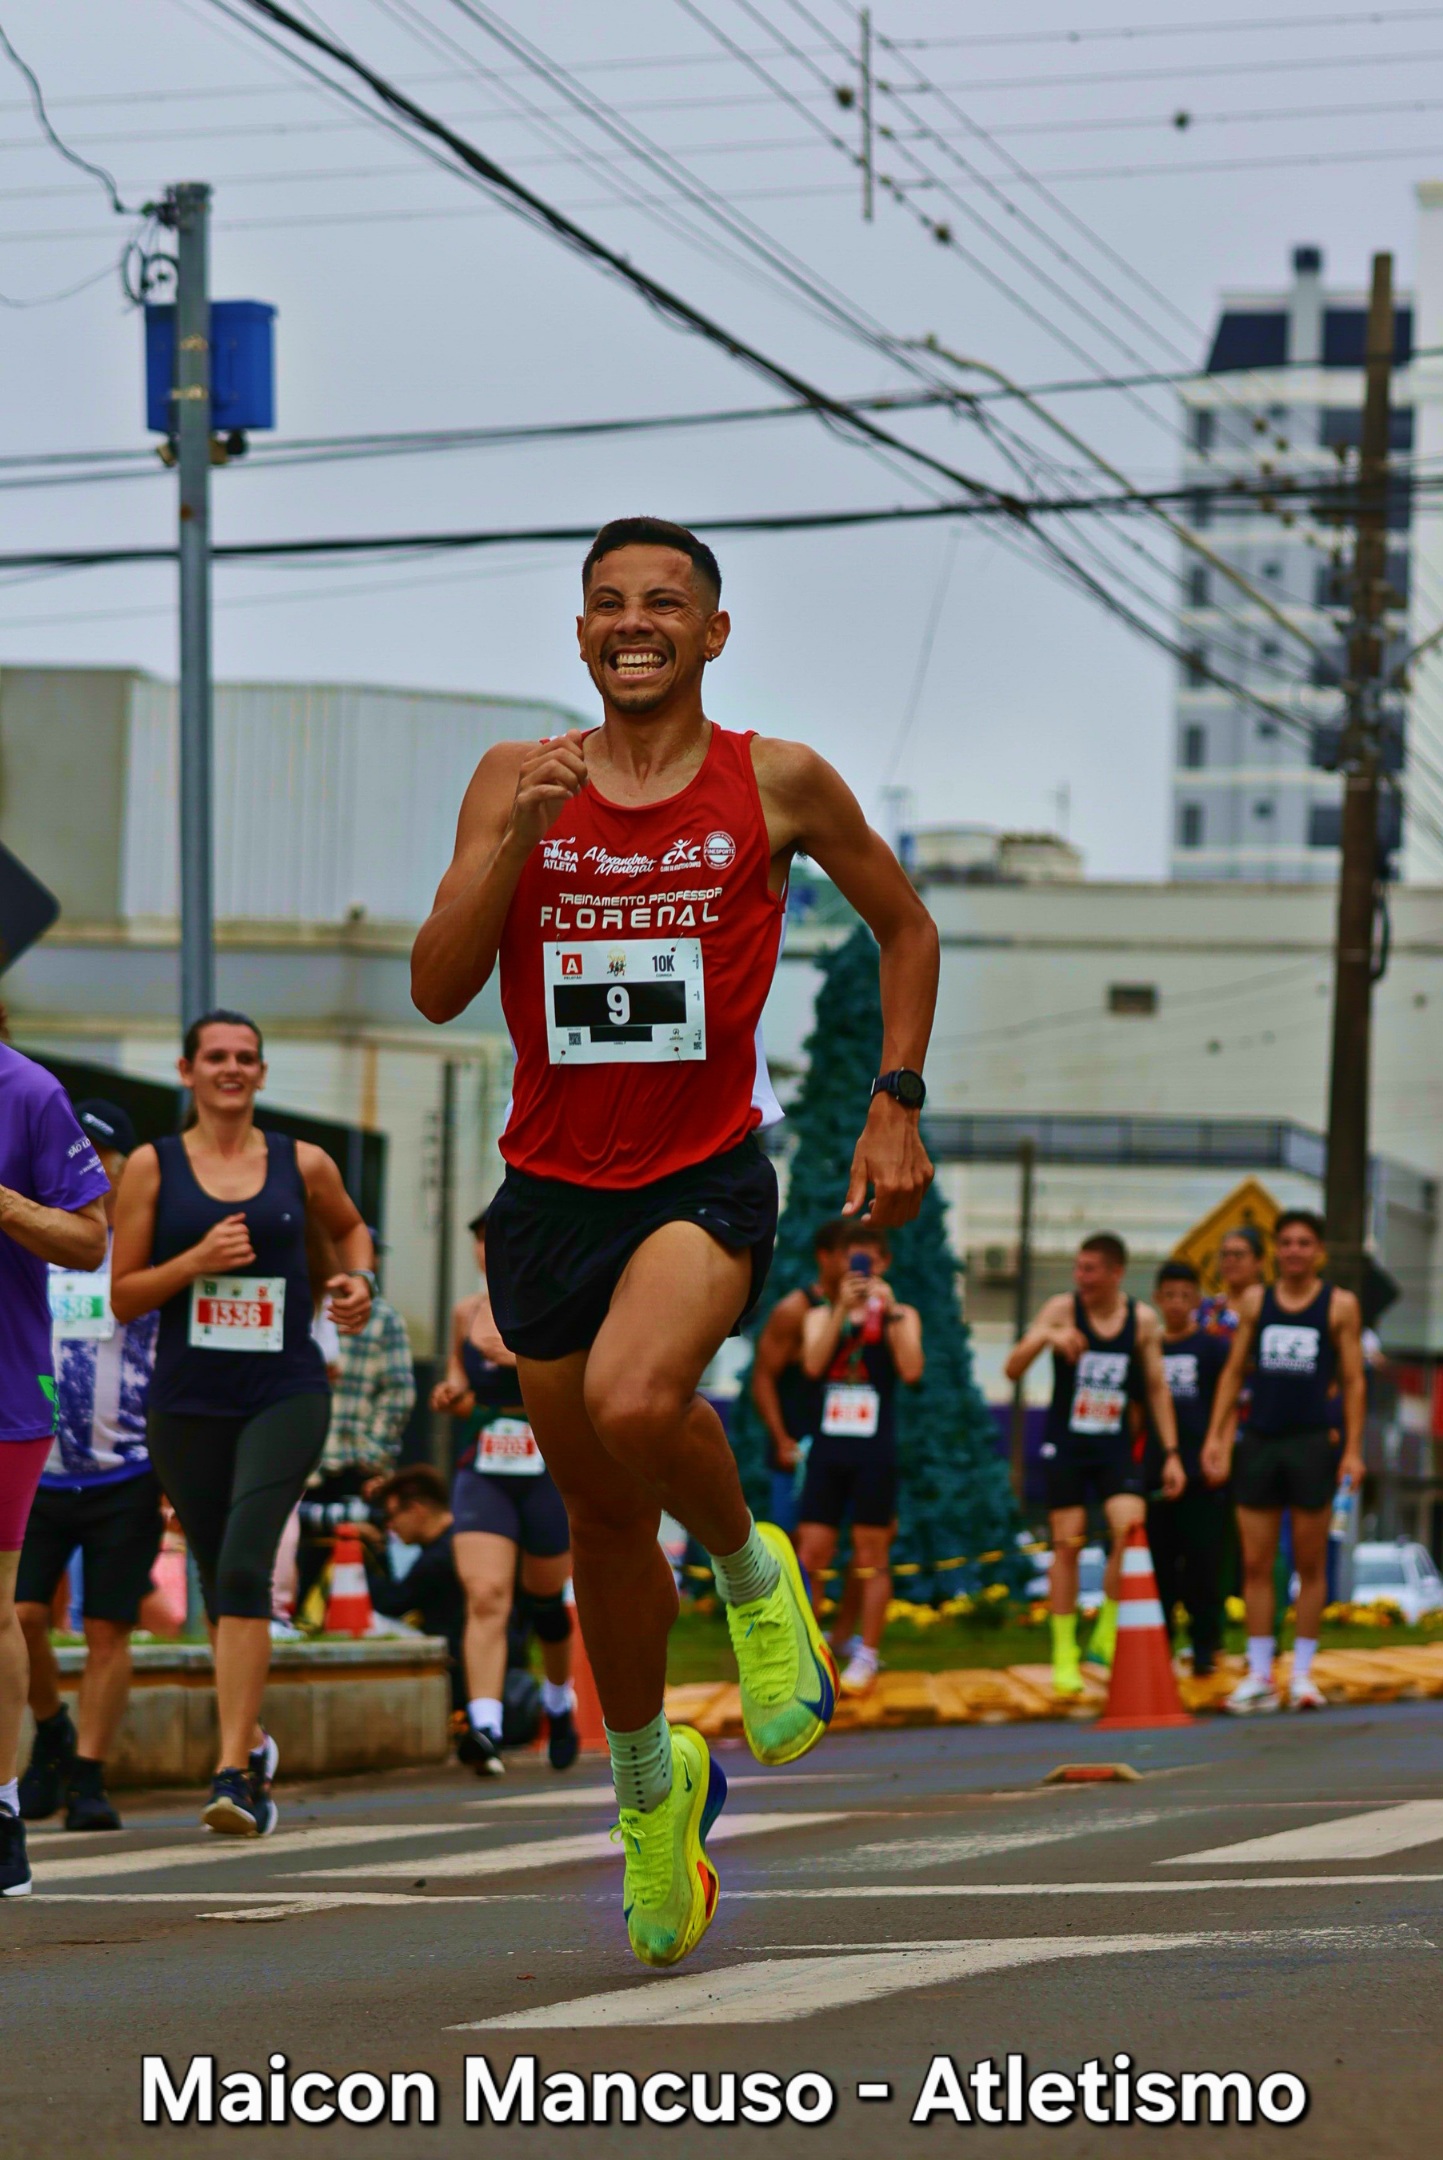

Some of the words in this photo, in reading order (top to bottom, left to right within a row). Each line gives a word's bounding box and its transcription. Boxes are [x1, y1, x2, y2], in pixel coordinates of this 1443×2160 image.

[543, 847, 578, 862] BOLSA
[582, 846, 649, 865] Alexandre
[543, 859, 577, 873] ATLETA
[594, 859, 657, 878] Menegat
[559, 893, 646, 906] TREINAMENTO
[648, 887, 722, 904] PROFESSOR
[540, 902, 719, 930] FLORENAL
[566, 957, 579, 974] A
[652, 954, 675, 972] 10K
[606, 985, 630, 1026] 9
[210, 1300, 262, 1327] 1336
